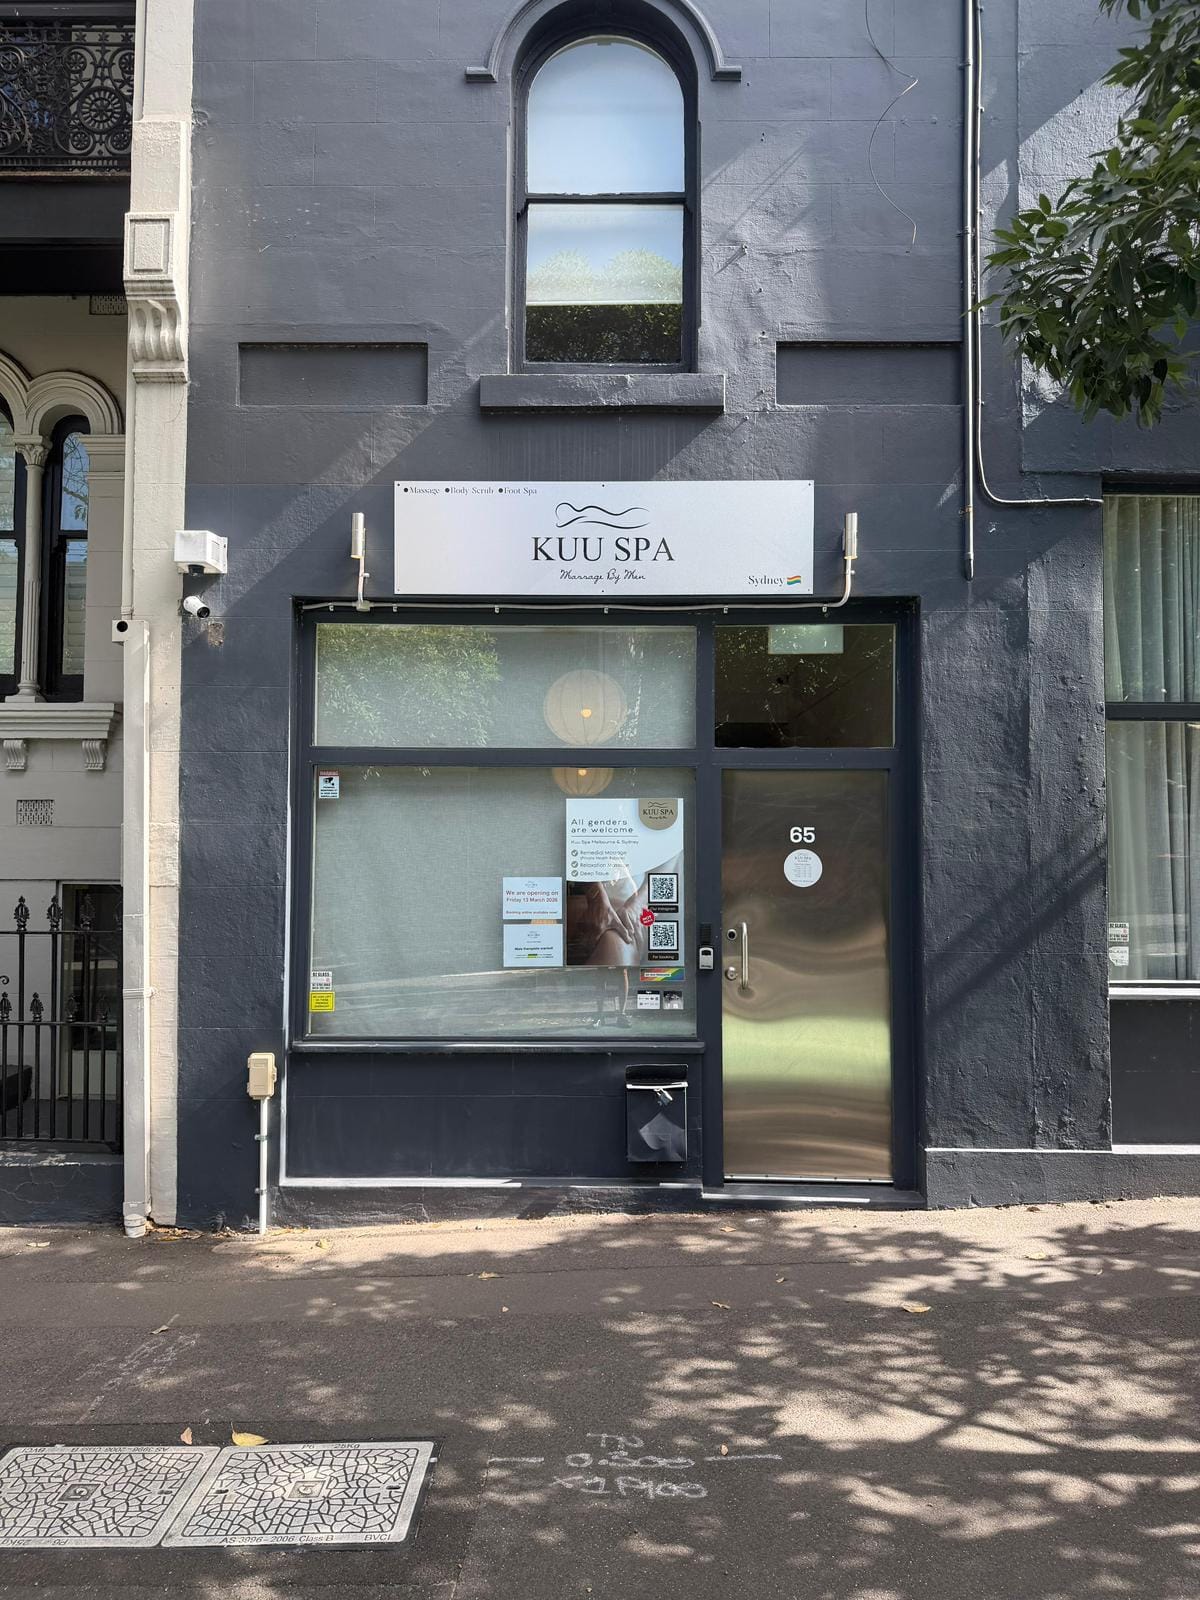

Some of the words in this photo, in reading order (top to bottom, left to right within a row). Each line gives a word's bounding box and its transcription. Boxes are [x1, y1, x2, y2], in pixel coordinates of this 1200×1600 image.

[409, 487, 440, 495] Massage
[450, 486, 469, 496] Body
[472, 486, 494, 494] Scrub
[523, 487, 537, 496] Spa
[531, 536, 604, 561] KUU
[614, 536, 675, 561] SPA
[559, 569, 604, 584] Massage
[606, 568, 620, 584] By
[624, 569, 646, 580] Men
[748, 575, 784, 587] Sydney
[588, 819, 628, 827] genders
[790, 826, 815, 843] 65
